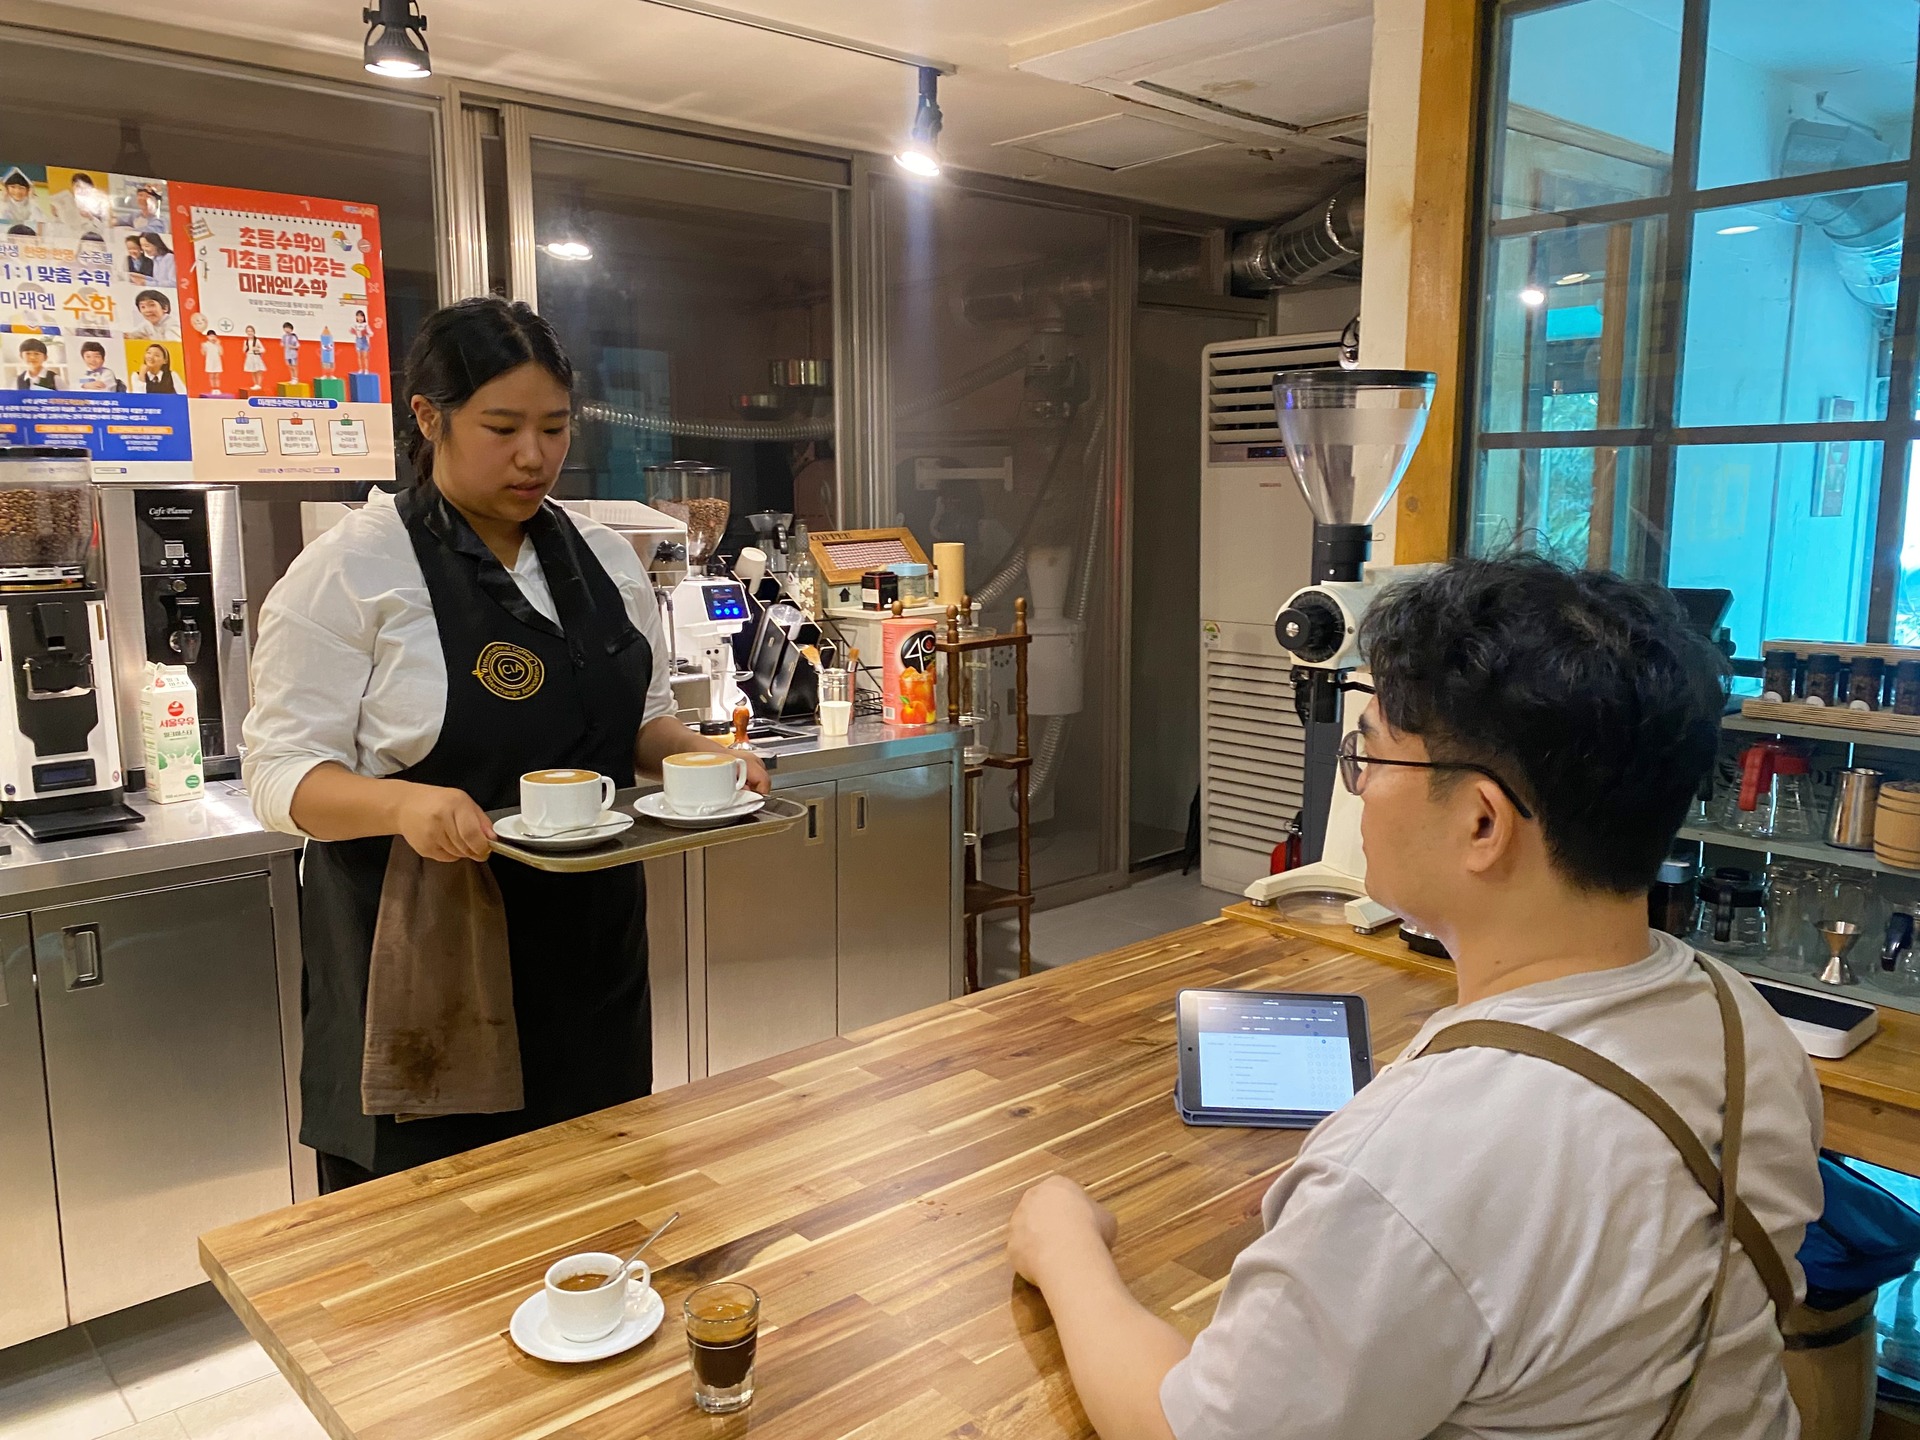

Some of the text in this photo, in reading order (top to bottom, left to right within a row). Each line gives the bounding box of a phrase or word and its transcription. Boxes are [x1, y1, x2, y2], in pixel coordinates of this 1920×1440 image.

[239, 226, 326, 253] 초등수학의
[79, 251, 113, 265] 수준별
[219, 248, 346, 278] 기초를 잡아주는
[37, 266, 72, 284] 맞춤
[77, 269, 111, 287] 수학
[238, 272, 328, 299] 미래엔수학
[0, 290, 116, 322] 미래엔 수학
[810, 532, 853, 541] COFFEE
[159, 717, 195, 728] 서울우유
